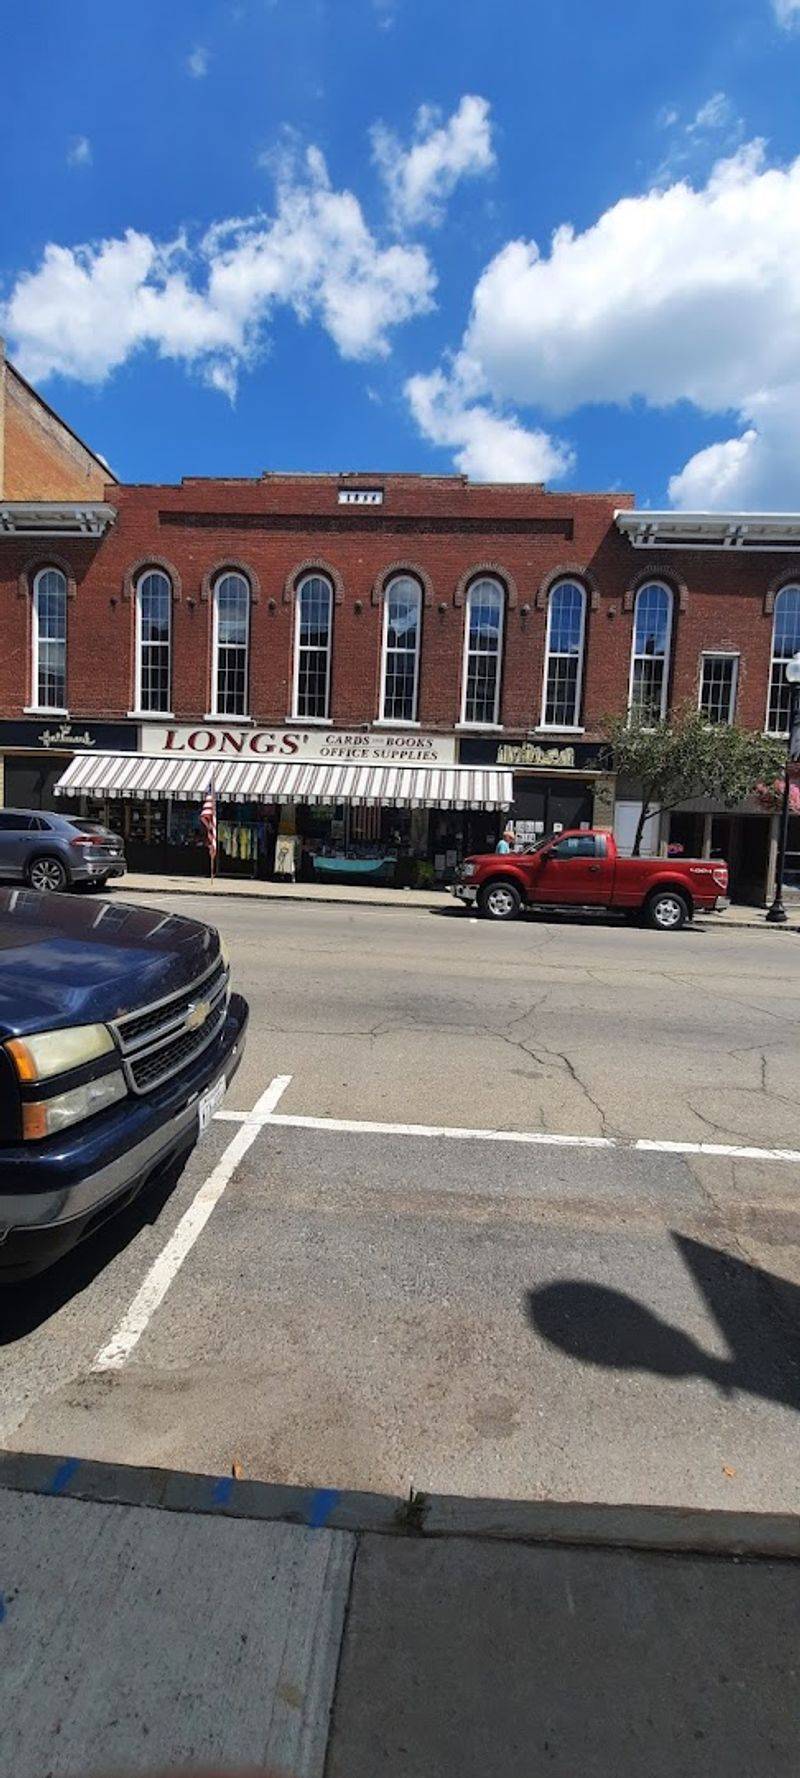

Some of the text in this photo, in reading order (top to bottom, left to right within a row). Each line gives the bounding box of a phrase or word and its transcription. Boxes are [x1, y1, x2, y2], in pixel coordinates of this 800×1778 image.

[162, 729, 309, 755] LONGS'
[325, 734, 371, 746] CARDS
[385, 736, 434, 748] BOOKS
[319, 747, 439, 761] OFFICE SUPPLIES
